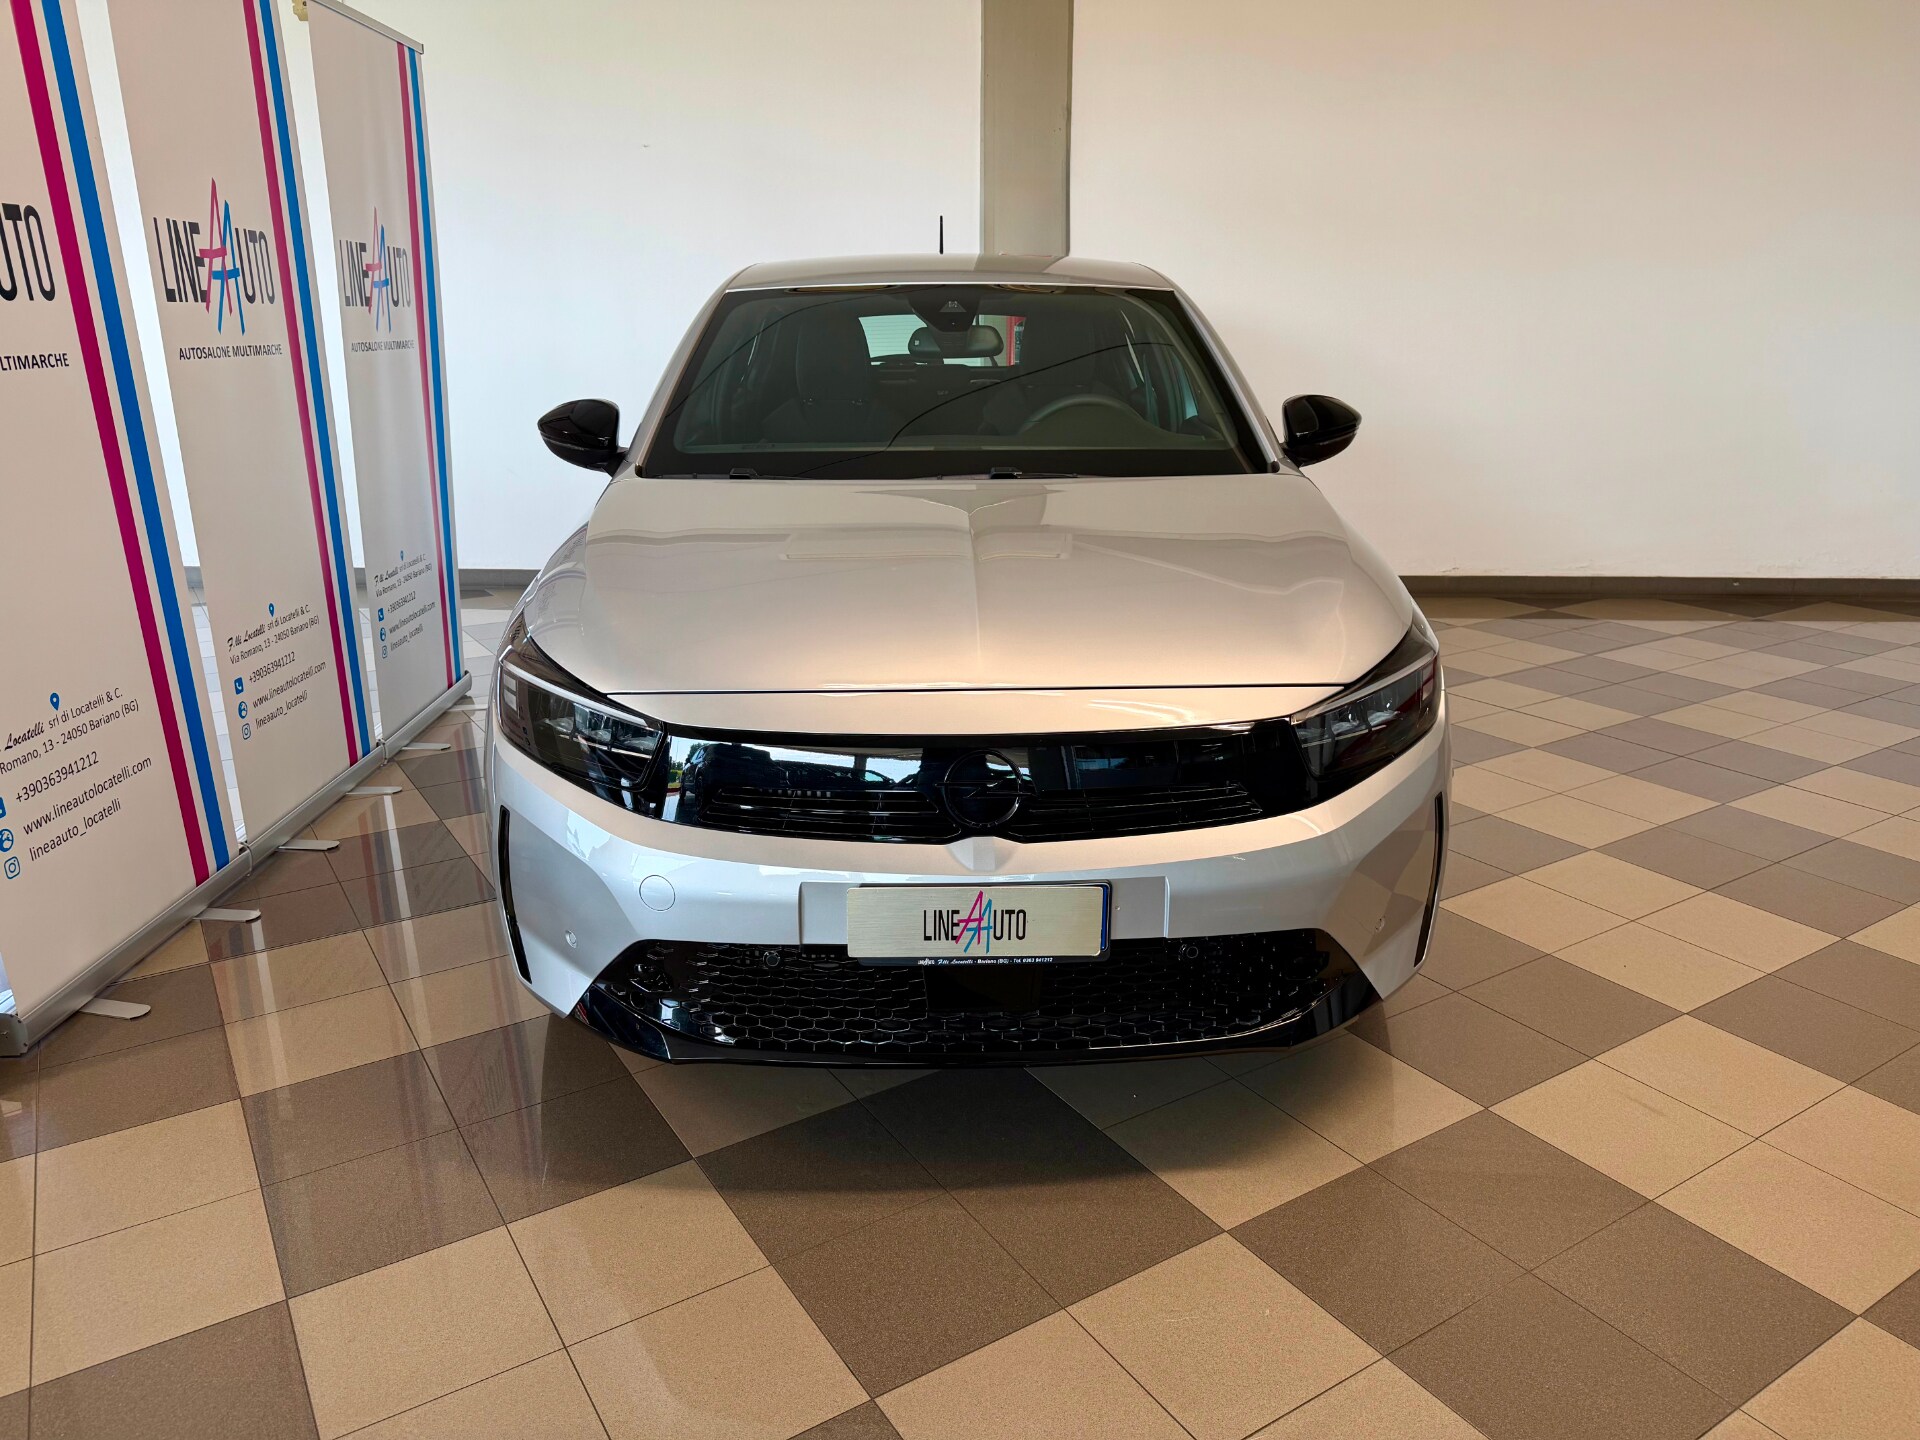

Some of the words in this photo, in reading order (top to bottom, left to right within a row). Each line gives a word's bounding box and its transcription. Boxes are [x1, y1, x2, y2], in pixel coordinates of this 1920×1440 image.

[179, 345, 231, 360] AUTOSALONE
[232, 344, 282, 358] MULTIMARCHE
[351, 341, 383, 352] AUTOSALONE
[384, 339, 414, 351] MULTIMARCHE
[230, 655, 239, 664] Via
[240, 644, 264, 660] Romano,
[264, 638, 271, 648] 13
[274, 629, 290, 644] 24050
[290, 620, 309, 636] Bariano
[309, 615, 320, 629] (BG)
[244, 623, 266, 642] Locatelli
[275, 617, 280, 627] di
[280, 608, 300, 625] Locatelli
[300, 606, 304, 616] &
[305, 604, 311, 613] C.
[249, 651, 295, 683] +390363941212
[252, 661, 327, 709] www.lineautolocatelli.com
[4, 721, 45, 751] Locatelli
[48, 714, 59, 729] srl
[61, 710, 69, 723] di
[71, 695, 105, 719] Locatelli
[105, 691, 113, 702] &
[114, 687, 122, 699] C.
[255, 690, 308, 730] lineaauto_locatelli
[0, 749, 42, 775] Romano,
[43, 739, 54, 754] 13
[61, 723, 88, 745] 24050
[89, 710, 120, 731] Bariano
[121, 699, 139, 718] (BG)
[16, 750, 99, 803] +390363941212
[23, 757, 152, 835] www.lineautolocatelli.com
[29, 798, 121, 861] lineaauto_locatelli
